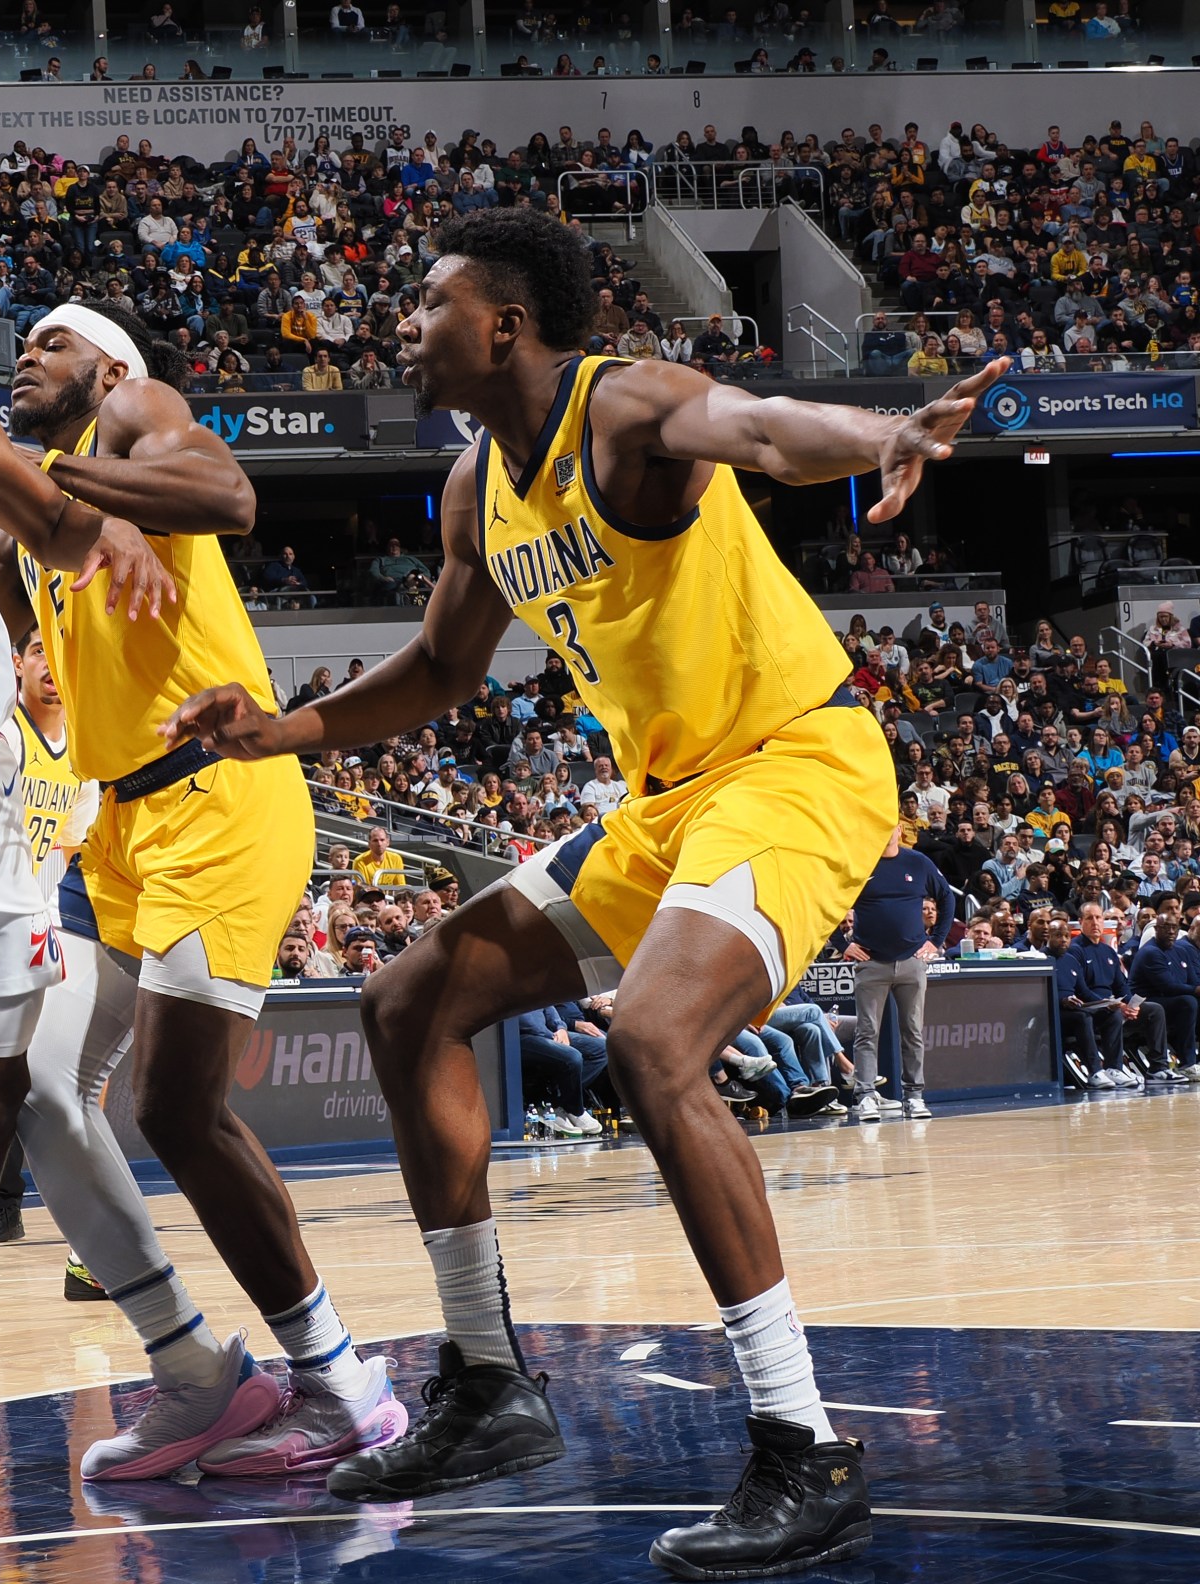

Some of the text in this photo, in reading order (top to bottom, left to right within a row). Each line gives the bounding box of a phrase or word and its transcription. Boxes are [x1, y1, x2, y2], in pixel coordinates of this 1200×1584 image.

[103, 85, 284, 104] NEED ASSISTANCE?
[600, 91, 608, 110] 7
[693, 90, 701, 109] 8
[38, 111, 75, 128] THE
[78, 109, 133, 127] ISSUE
[135, 109, 150, 126] &
[153, 107, 240, 125] LOCATION
[243, 107, 267, 124] TO
[271, 106, 397, 124] 707-TIMEOUT.
[263, 123, 315, 144] (707)
[1038, 392, 1184, 416] Sports Tech HQ
[489, 514, 616, 608] INDIANA
[1123, 602, 1131, 623] 9
[545, 599, 601, 686] 3
[29, 816, 57, 862] 26
[940, 963, 960, 973] BOLD
[819, 979, 855, 995] BO
[323, 1089, 388, 1122] driving
